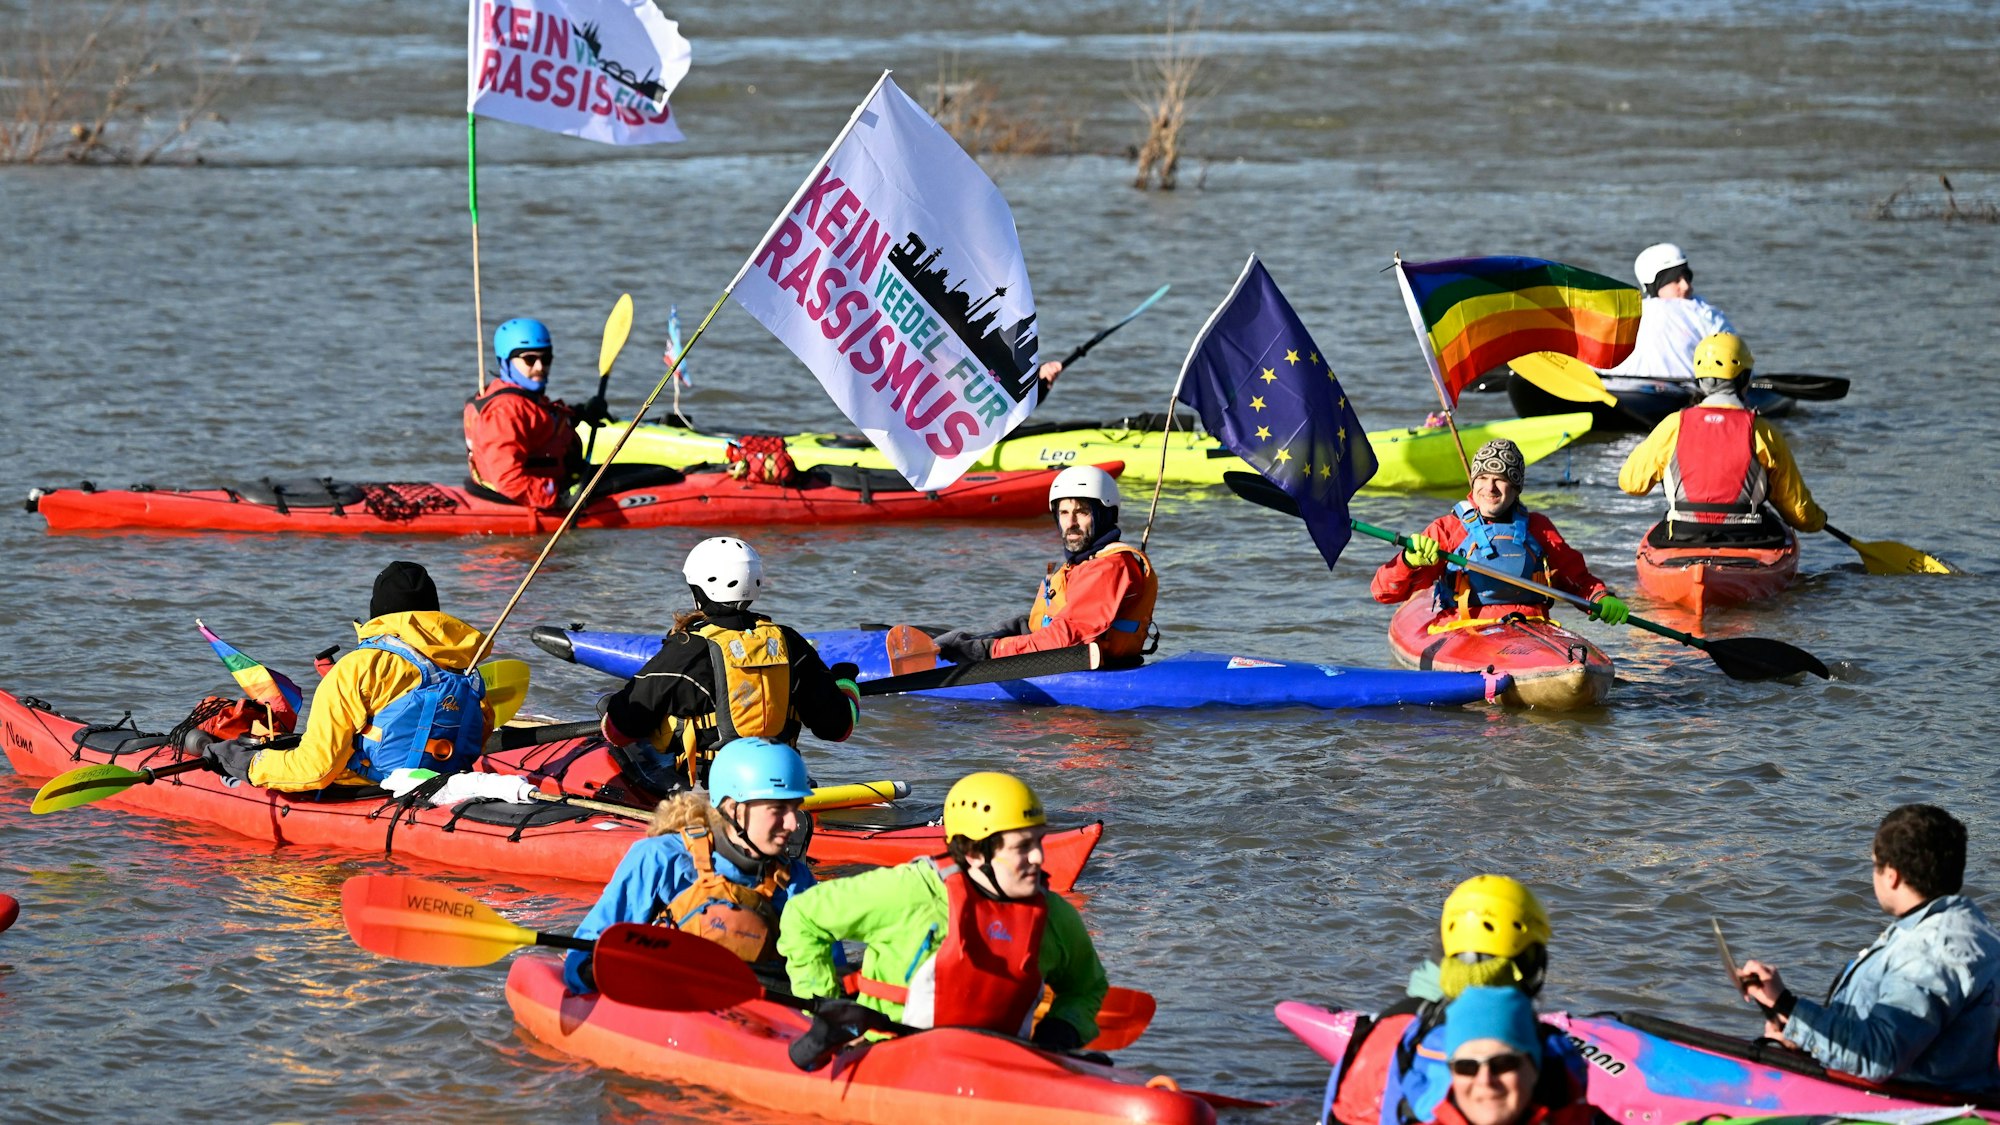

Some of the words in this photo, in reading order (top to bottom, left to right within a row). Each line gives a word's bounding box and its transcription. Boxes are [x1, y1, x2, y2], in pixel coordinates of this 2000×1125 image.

[483, 3, 568, 60] KEIN
[478, 49, 670, 126] RASSIS
[793, 165, 891, 284] KEIN
[755, 217, 980, 460] RASSISMUS
[874, 264, 949, 364] VEEDEL
[944, 356, 1009, 428] FÜR
[1040, 448, 1076, 461] Leo
[6, 721, 34, 754] Nemo
[407, 894, 475, 919] WERNER
